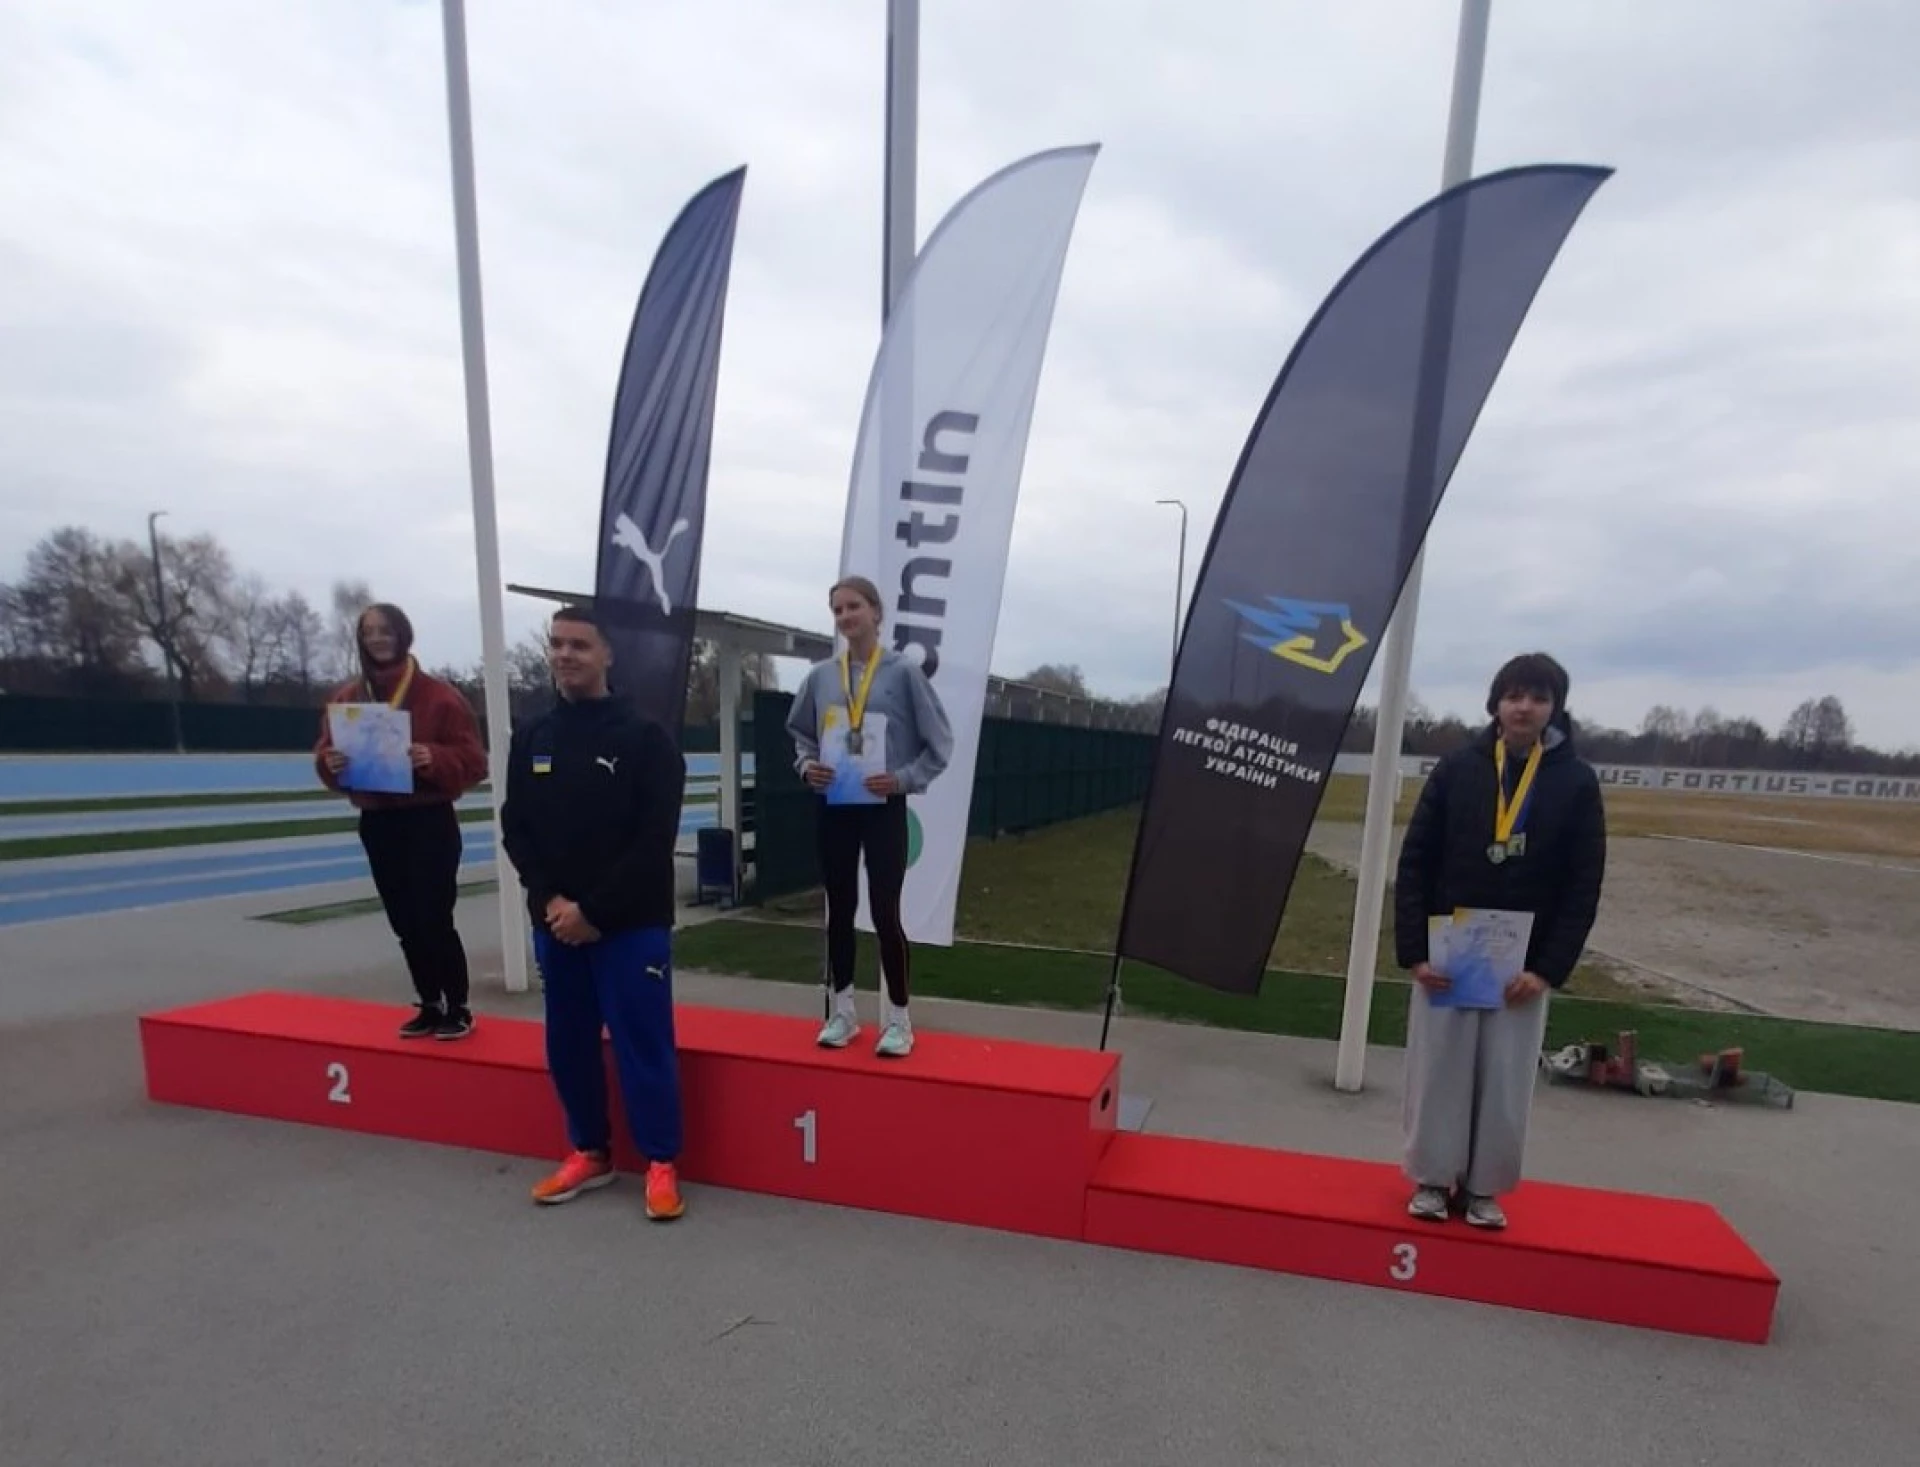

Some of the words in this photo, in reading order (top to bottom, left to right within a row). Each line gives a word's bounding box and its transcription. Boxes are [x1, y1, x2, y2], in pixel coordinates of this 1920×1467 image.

[1172, 727, 1233, 755] ЛЕГКОЇ
[1233, 745, 1321, 784] АТЛЕТИКИ
[1206, 717, 1299, 757] ФЕДЕРАЦІЯ
[1204, 755, 1278, 789] УКРАЇНИ
[327, 1062, 351, 1103] 2
[794, 1110, 816, 1163] 1
[1390, 1243, 1418, 1280] 3
